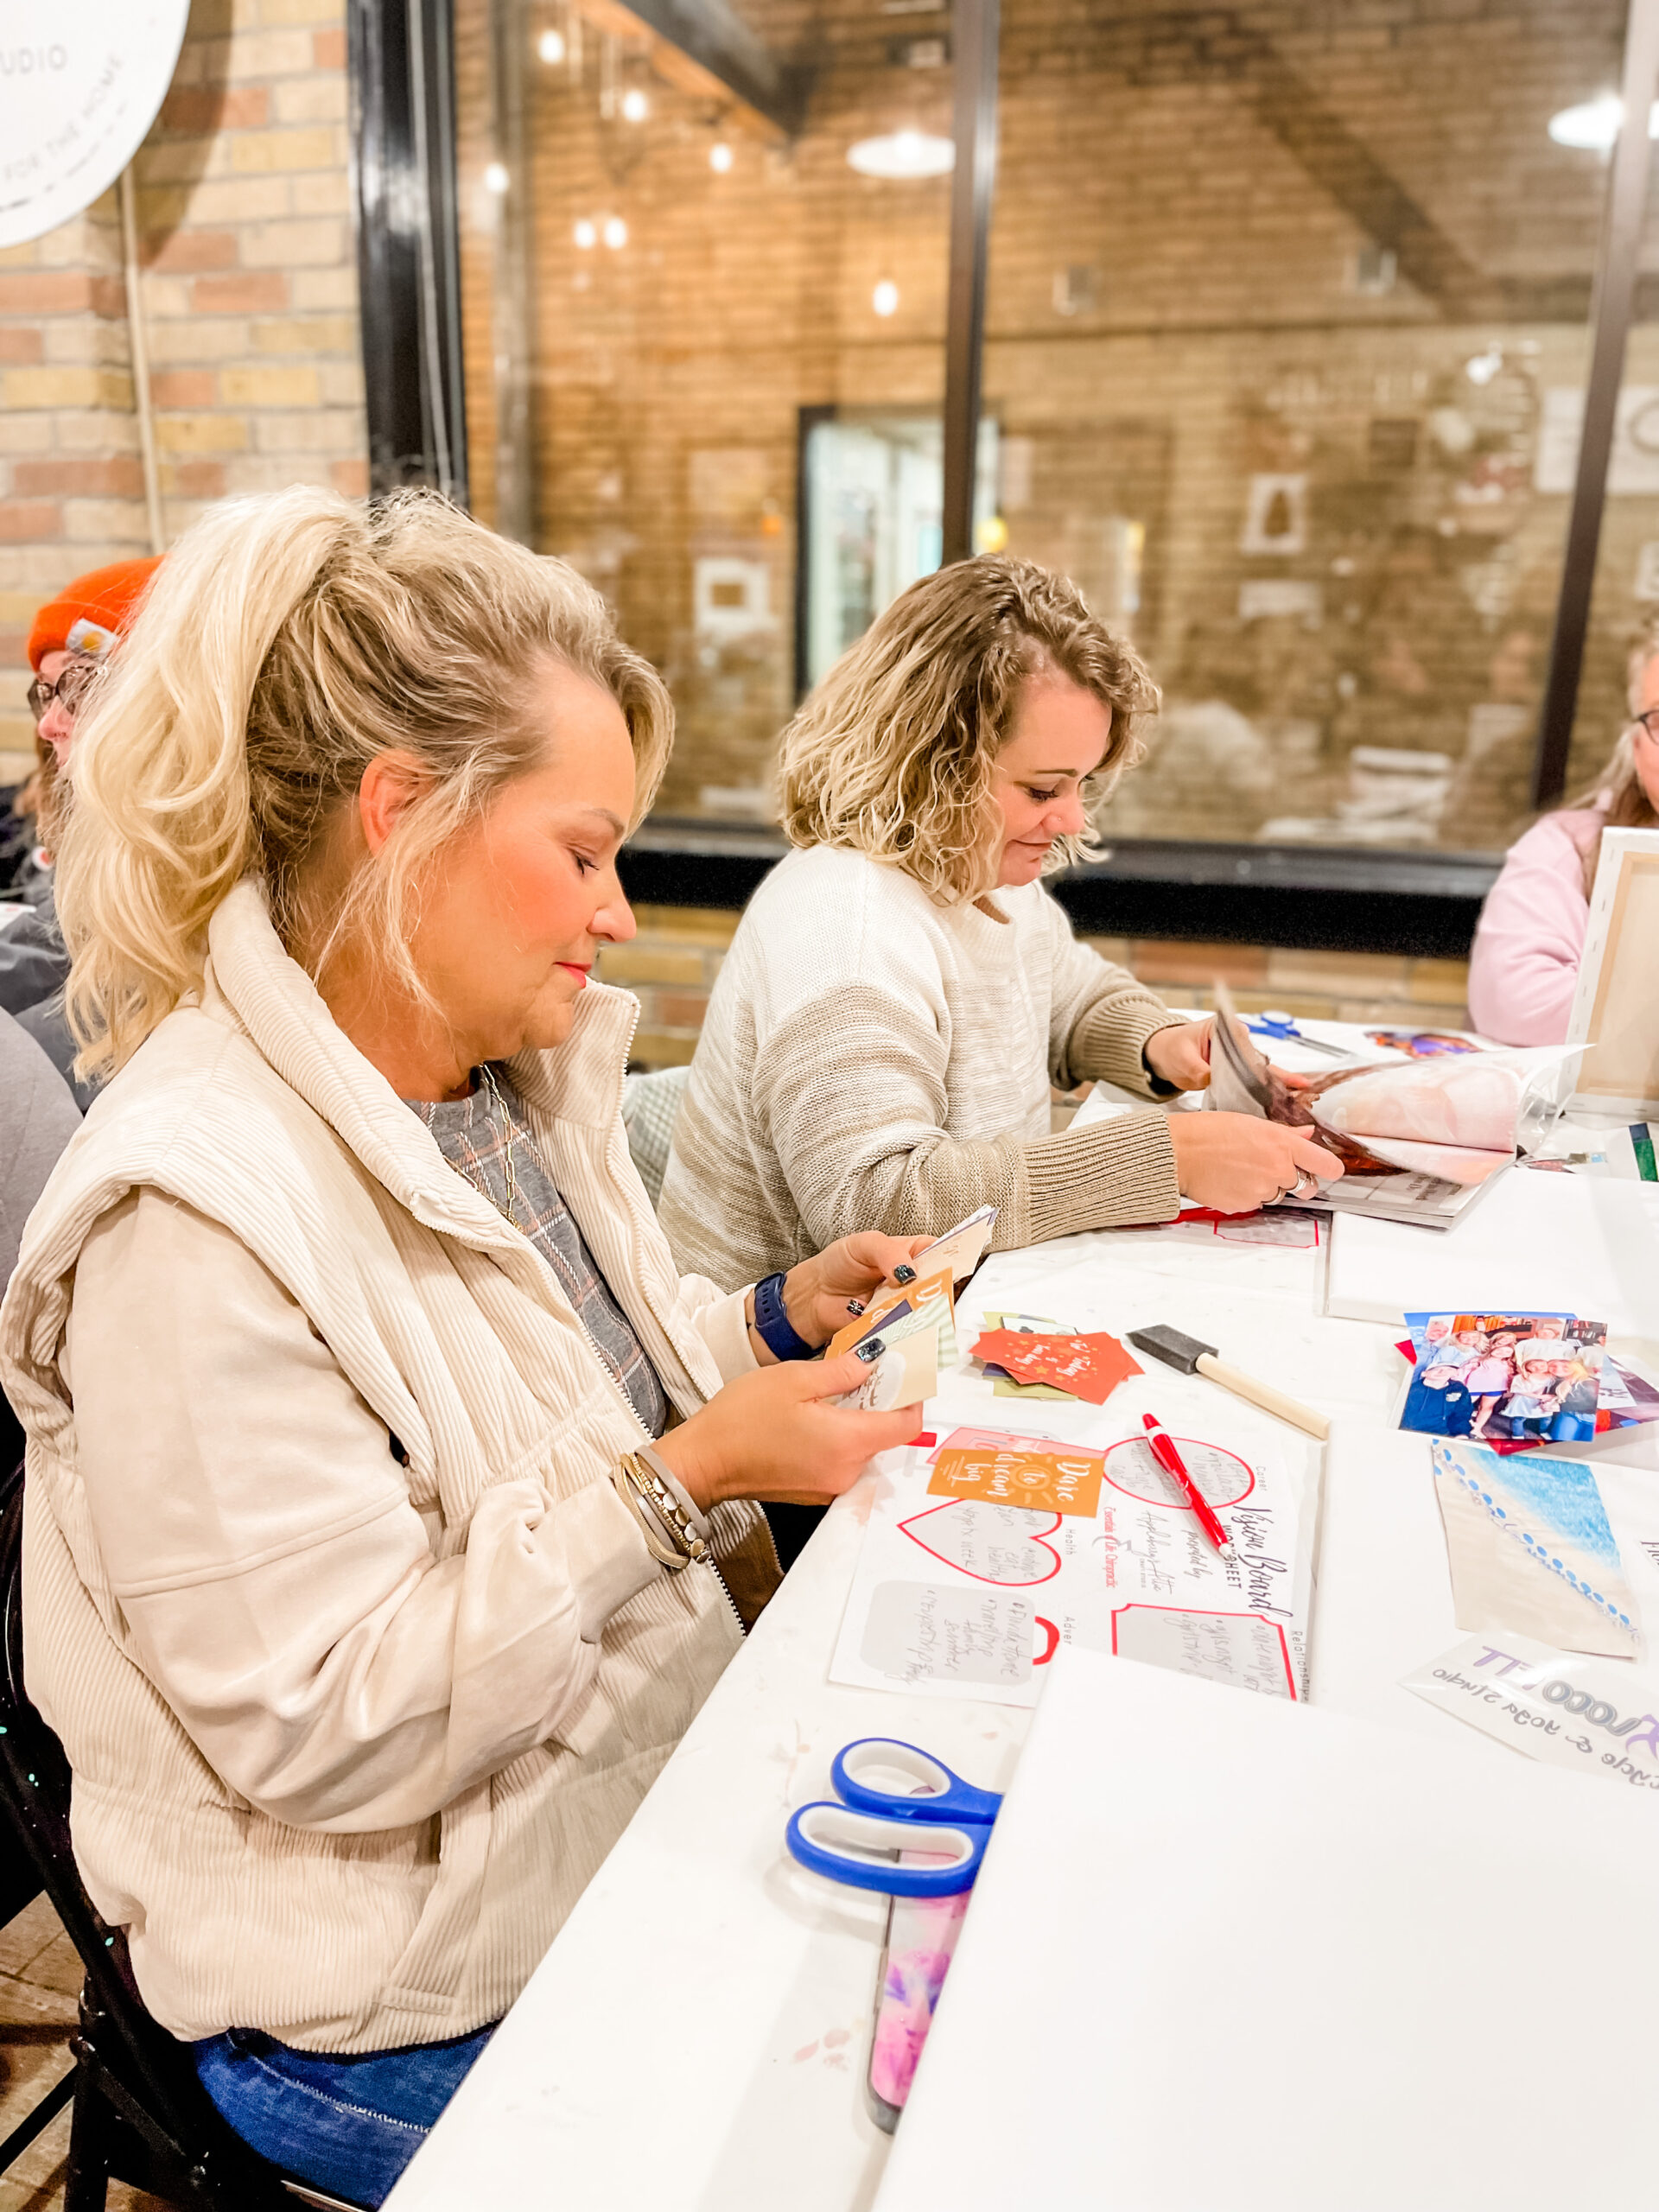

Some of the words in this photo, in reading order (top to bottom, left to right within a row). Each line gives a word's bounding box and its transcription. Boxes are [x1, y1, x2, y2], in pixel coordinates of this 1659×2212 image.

[45, 119, 80, 157] THE
[79, 51, 124, 119] HOME
[952, 1463, 991, 1482] big
[987, 1453, 1025, 1497] dream
[1023, 1471, 1047, 1485] to
[1057, 1461, 1091, 1502] Dare
[1255, 1465, 1267, 1491] Career
[1104, 1507, 1116, 1533] Essentials
[1230, 1506, 1274, 1550] Vision
[1065, 1529, 1076, 1555] Health
[1182, 1530, 1207, 1566] presented
[1223, 1525, 1242, 1589] WORSHEET
[1103, 1554, 1118, 1588] Chiropractic
[1184, 1568, 1212, 1579] by
[1237, 1554, 1293, 1617] Board
